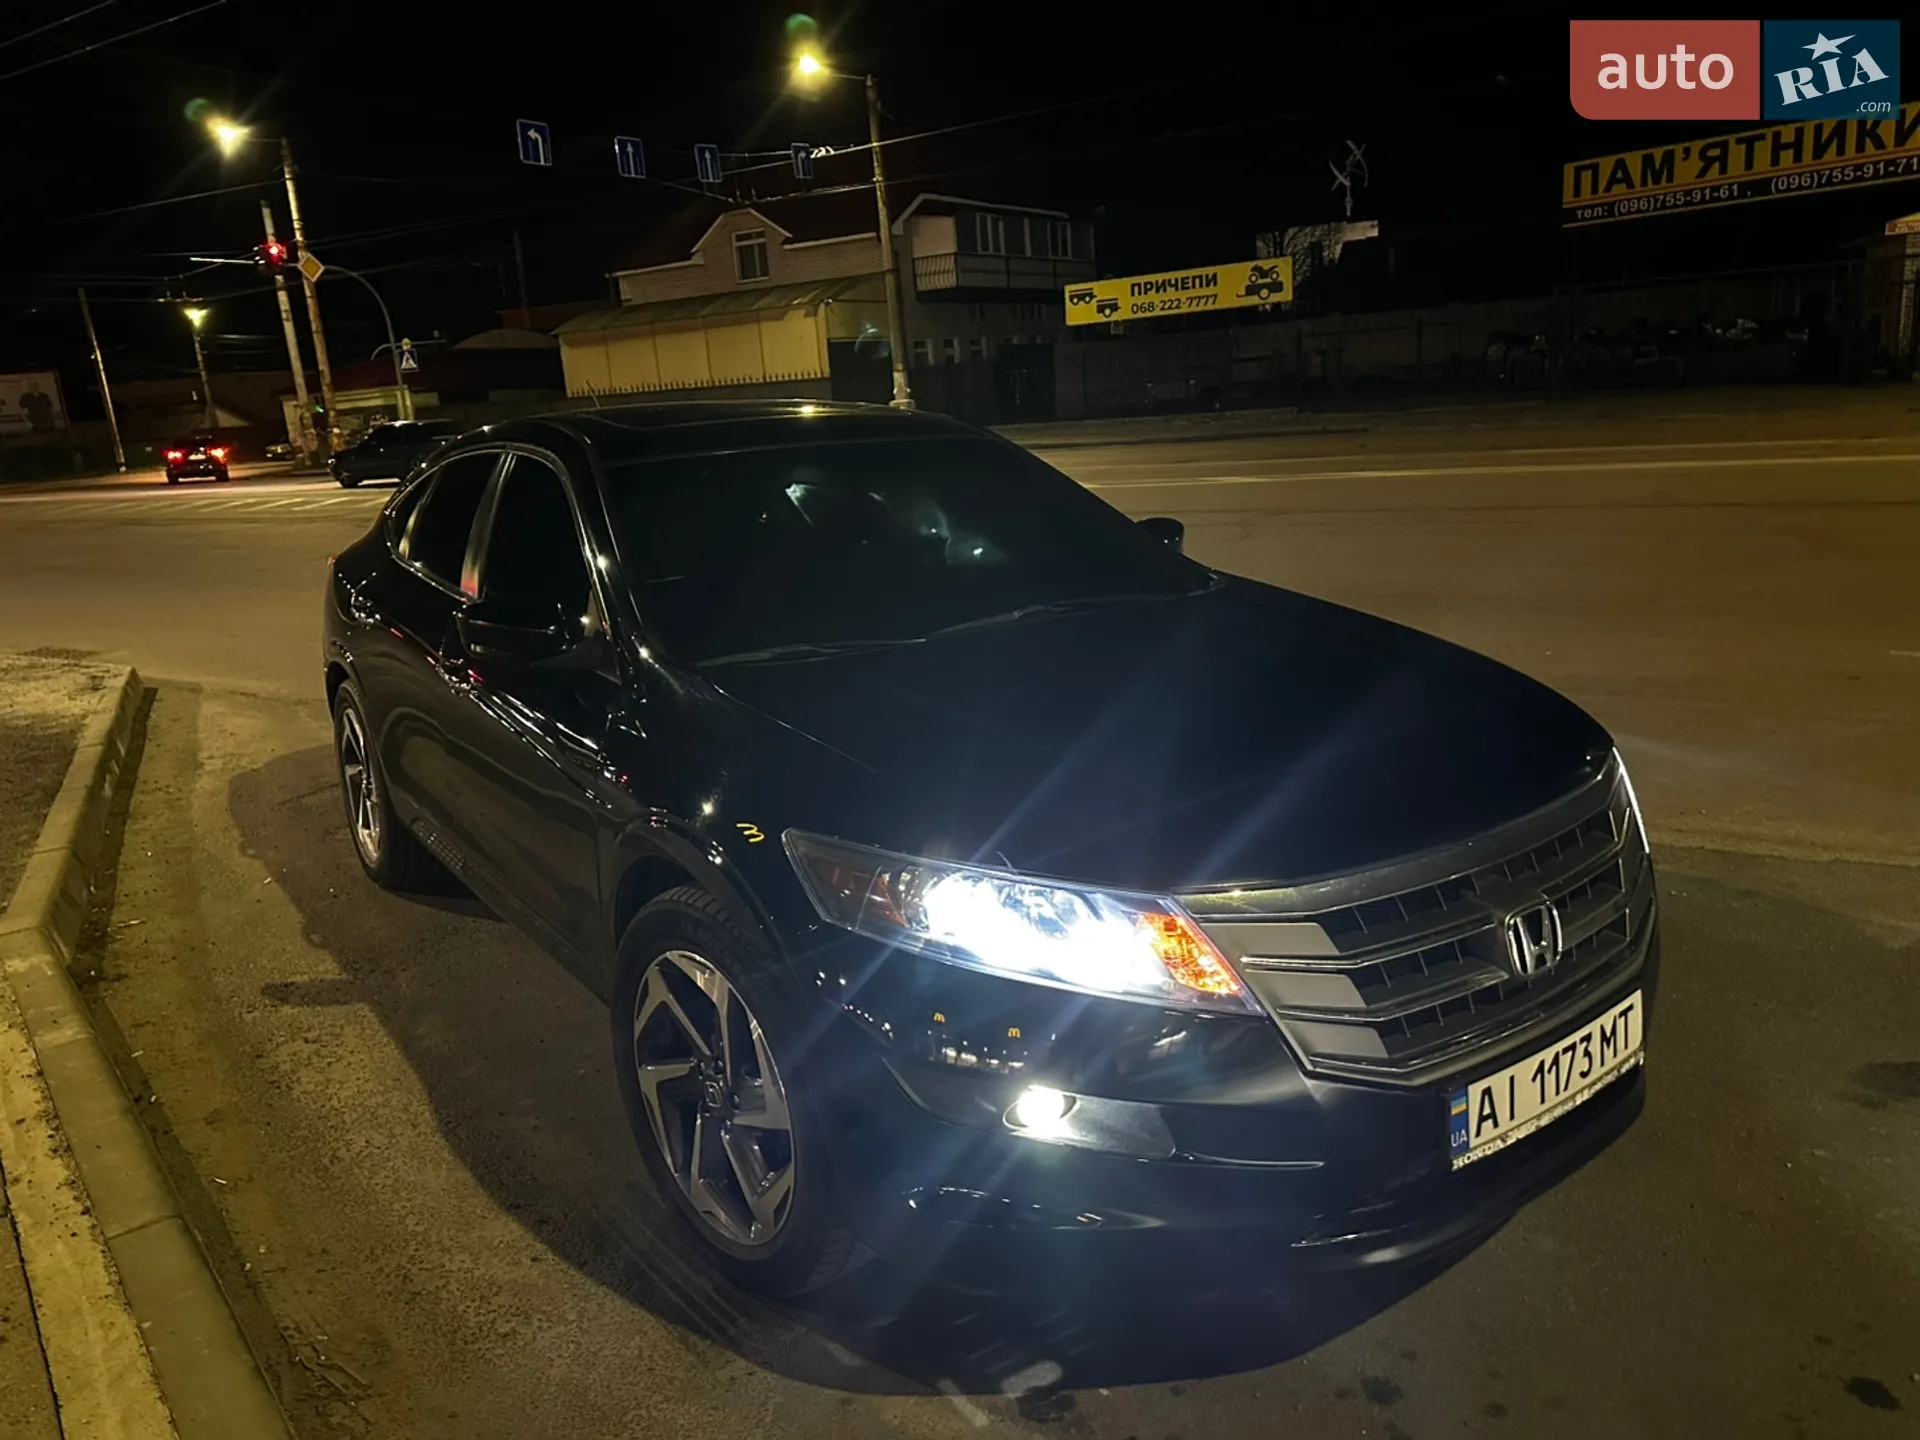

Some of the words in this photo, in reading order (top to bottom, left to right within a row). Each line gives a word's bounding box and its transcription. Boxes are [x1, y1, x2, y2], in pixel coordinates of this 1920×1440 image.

[1575, 205, 1609, 221] тел:
[1130, 272, 1218, 297] ПРИЧЕПИ
[1130, 293, 1219, 315] 068-222-7777
[1474, 1074, 1515, 1138] AI
[1531, 1031, 1593, 1105] 1173
[1600, 1003, 1634, 1068] MT
[1451, 1128, 1468, 1147] UA
